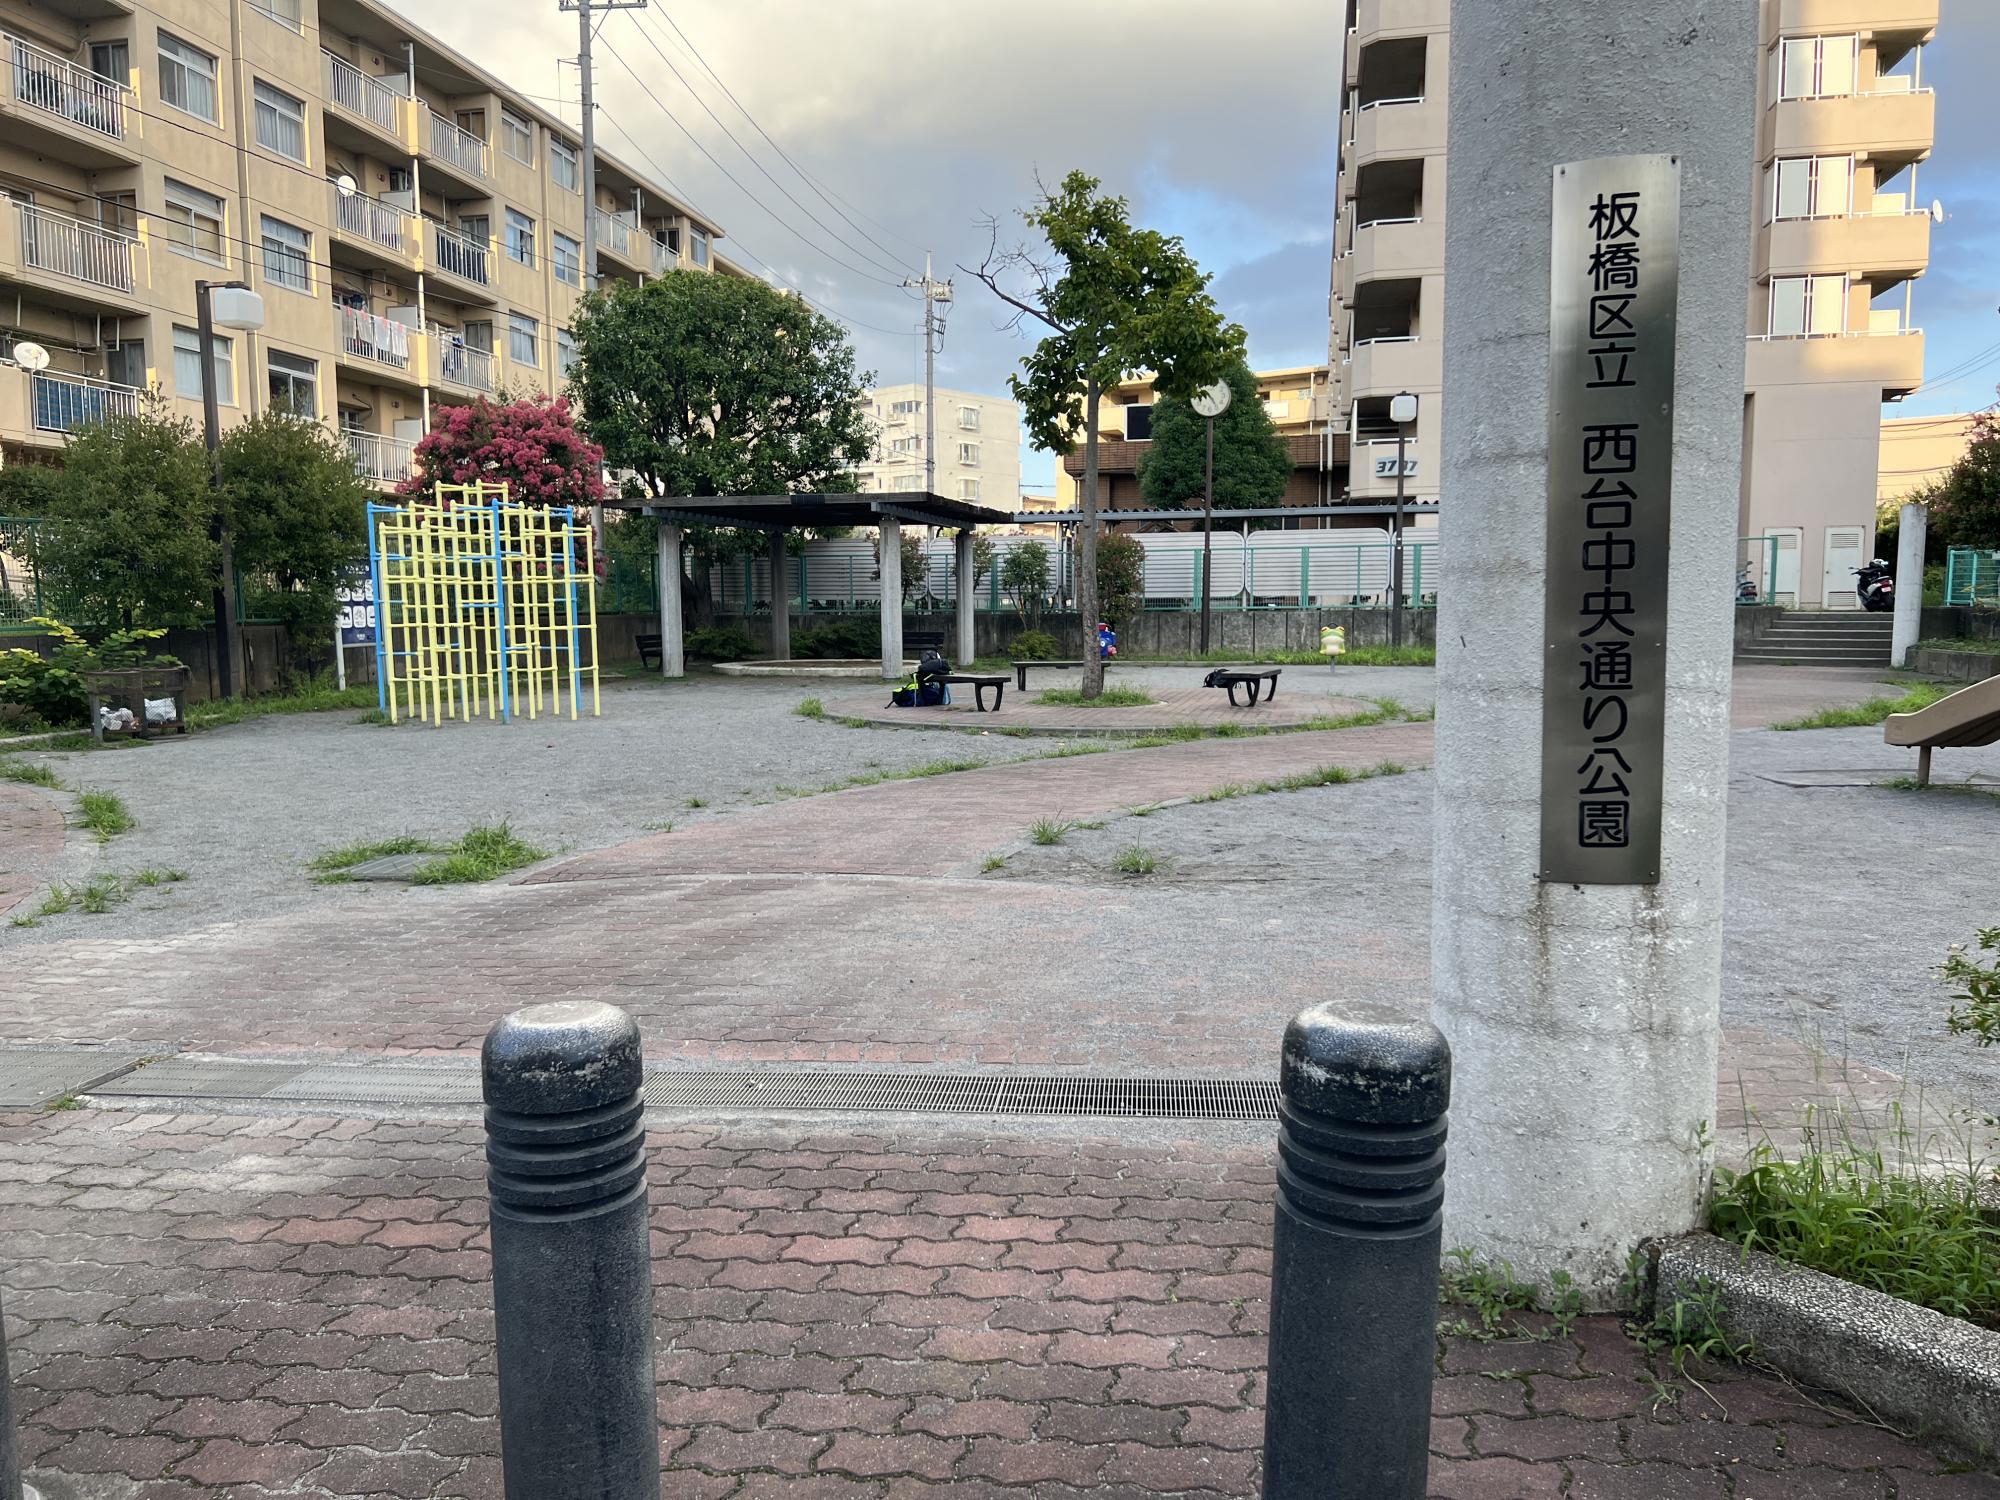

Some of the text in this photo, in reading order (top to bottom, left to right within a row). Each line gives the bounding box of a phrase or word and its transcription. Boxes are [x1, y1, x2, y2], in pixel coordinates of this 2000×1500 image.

[1577, 192, 1640, 847] 板橋区立 西台中央通り公園
